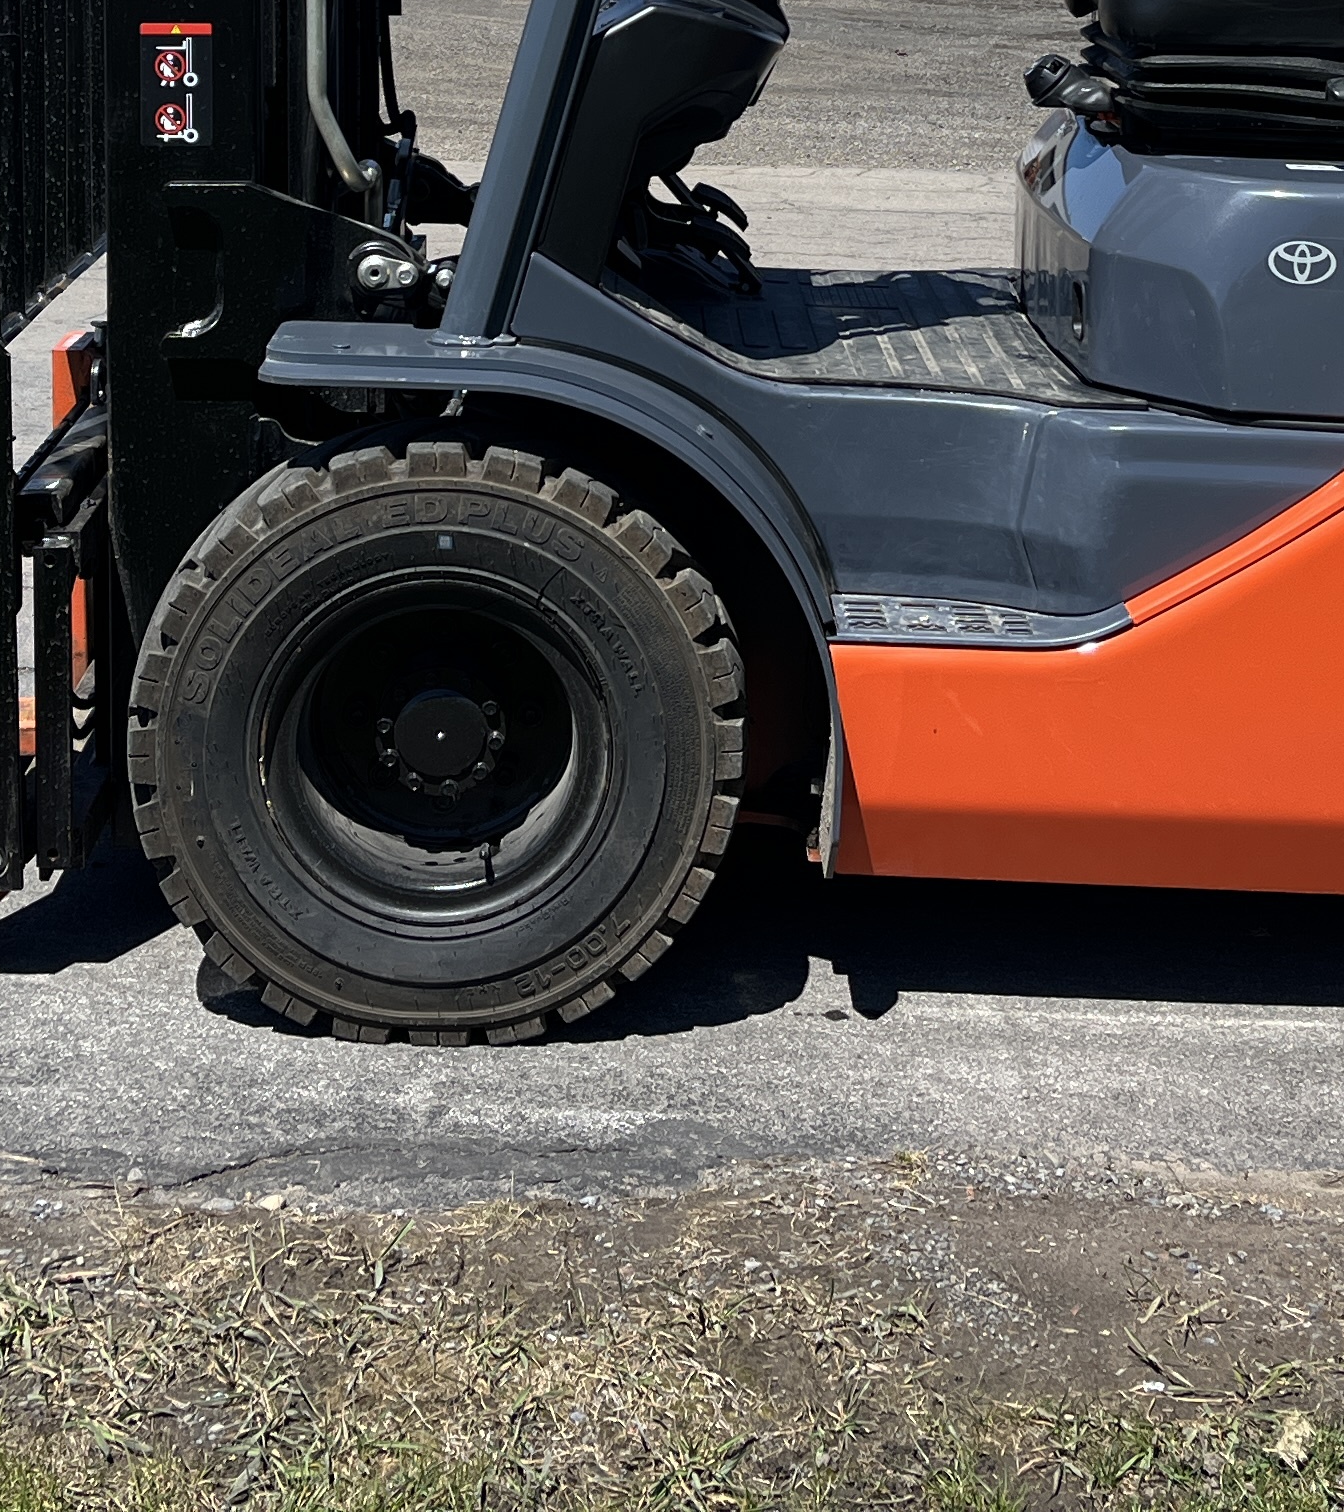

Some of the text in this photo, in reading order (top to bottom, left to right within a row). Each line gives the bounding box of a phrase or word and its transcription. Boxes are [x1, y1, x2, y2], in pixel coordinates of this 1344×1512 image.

[182, 512, 363, 705] SOLIDEAL
[459, 495, 585, 562] PLUS
[512, 912, 632, 999] 7.00-12
